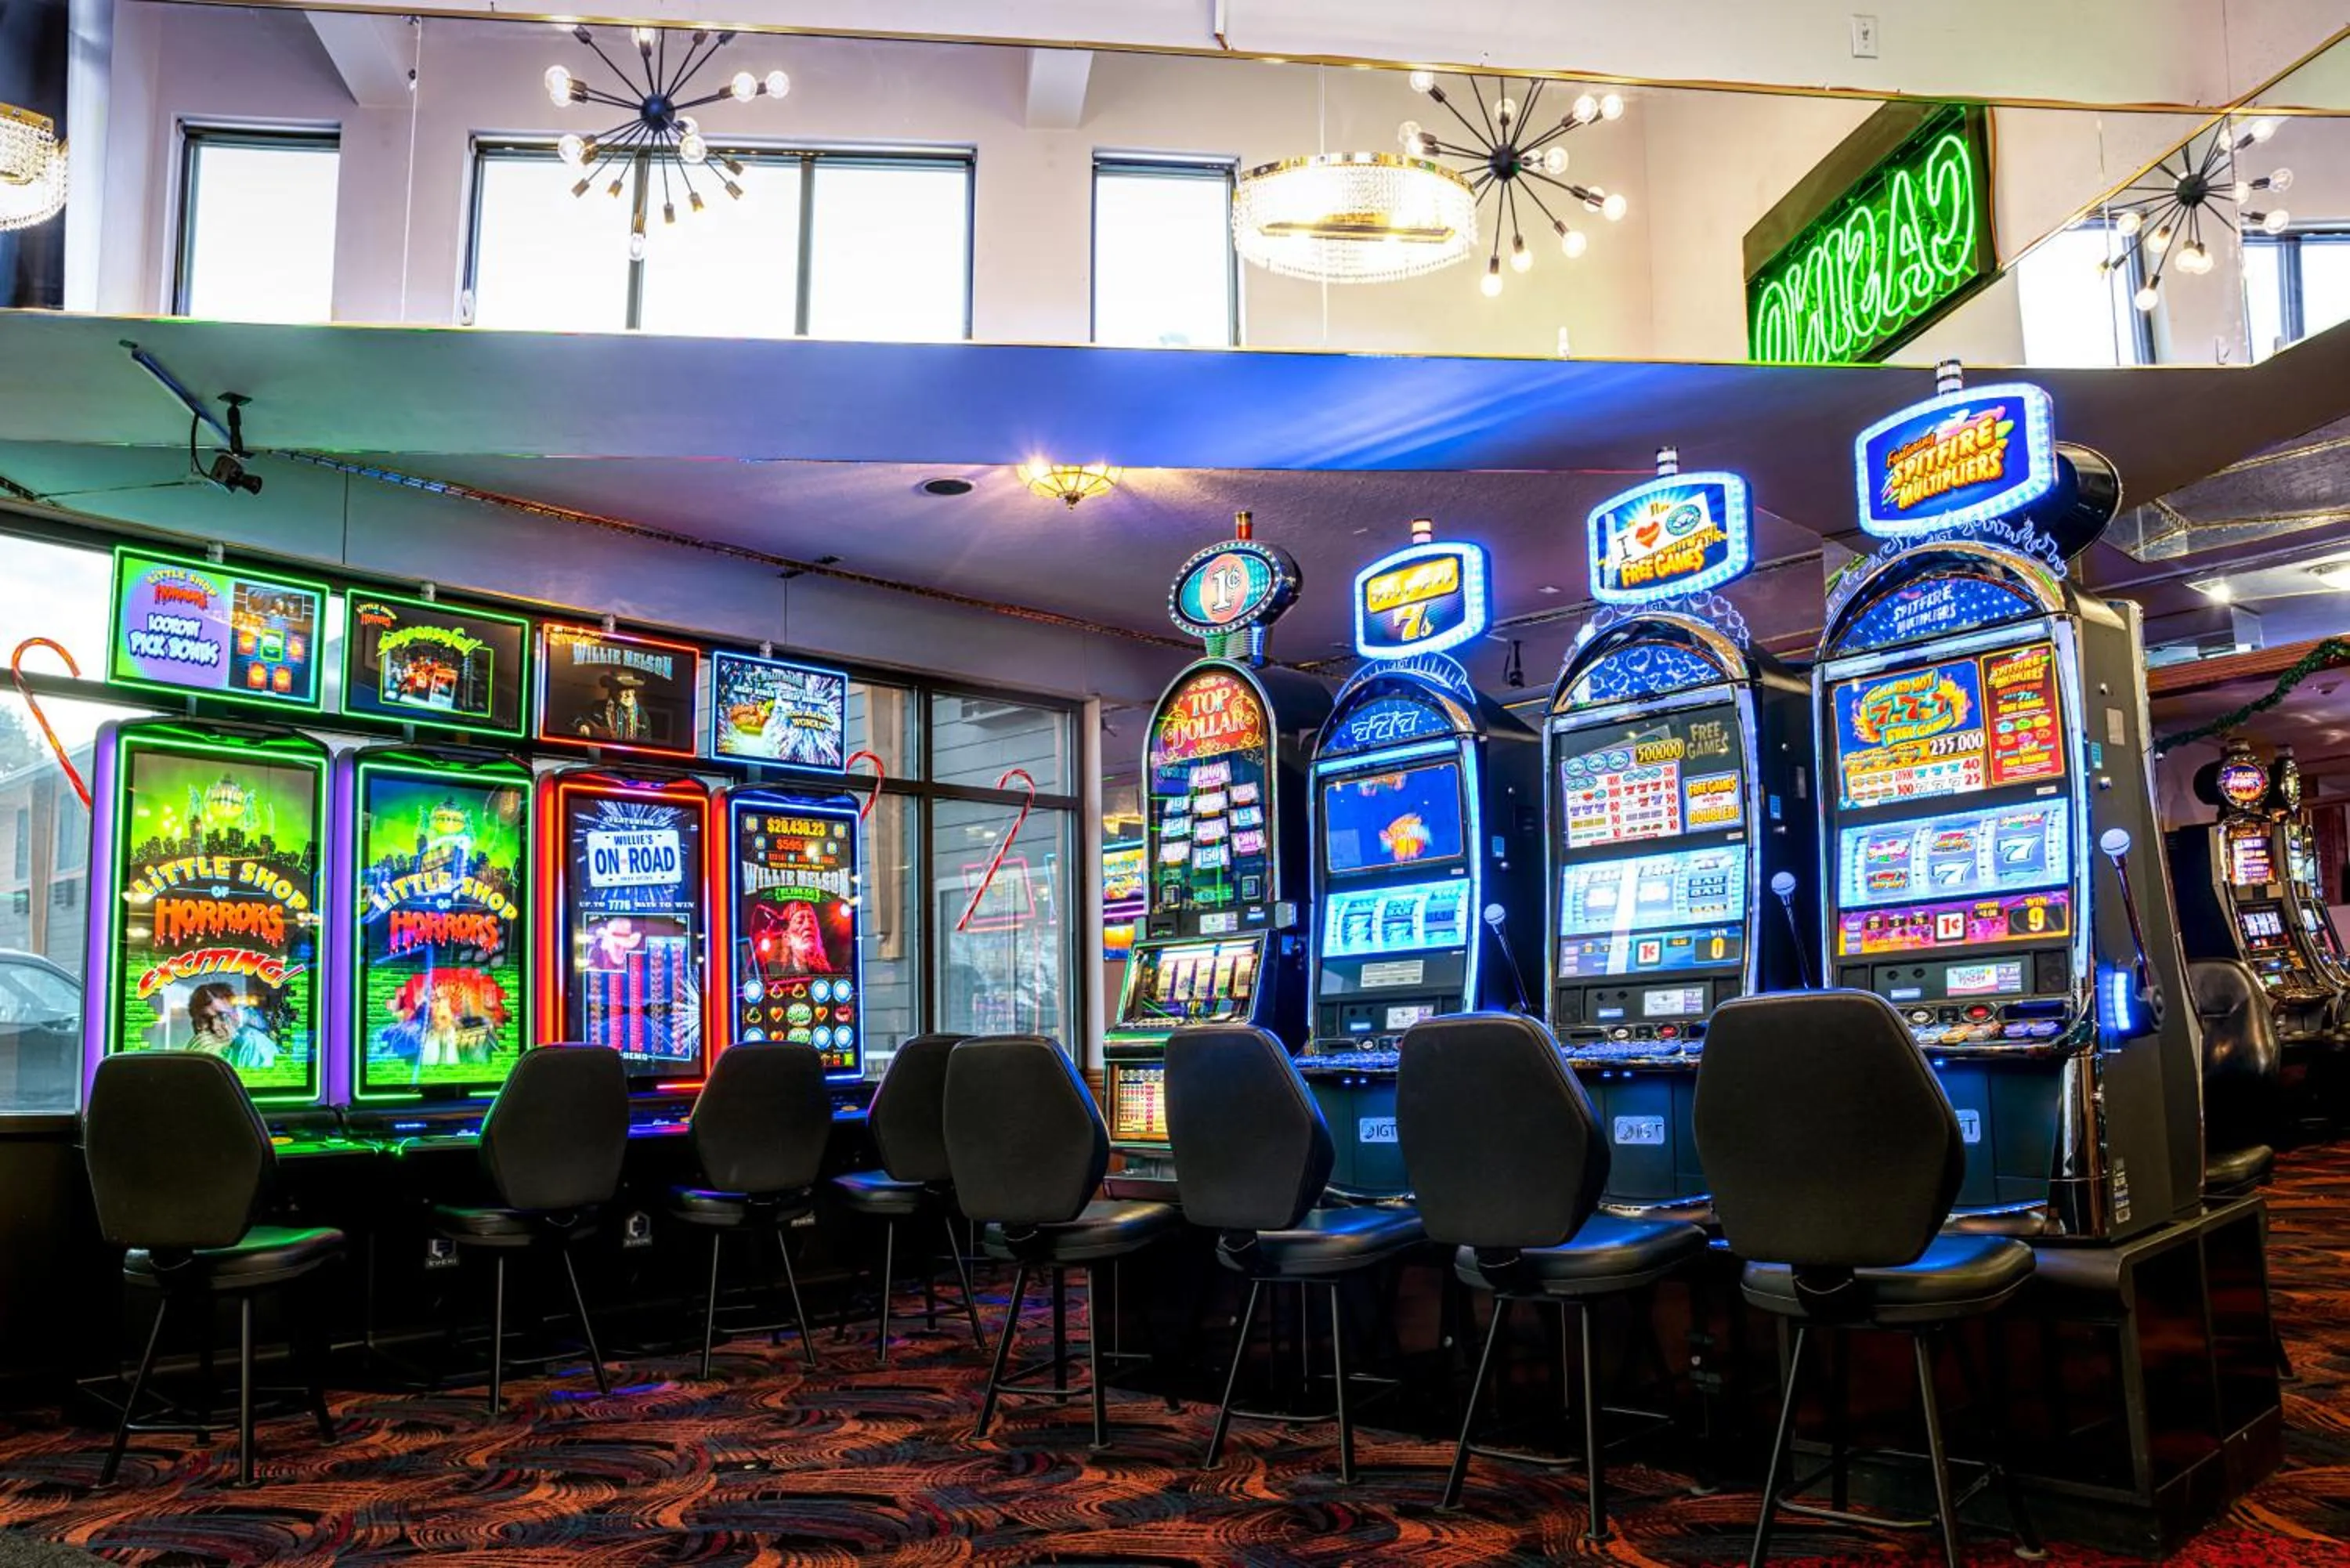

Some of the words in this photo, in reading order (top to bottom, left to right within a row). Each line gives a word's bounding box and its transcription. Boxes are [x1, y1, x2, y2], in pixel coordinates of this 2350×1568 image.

[1892, 416, 1997, 490] SPITFIRE
[1898, 447, 2004, 510] MULTIPLIERS
[1620, 562, 1655, 587] FREE
[1893, 583, 1954, 621] SPITFIRE
[1896, 602, 1957, 636] MULTIPLIERS
[573, 641, 621, 665] WILLIE
[623, 649, 673, 681] NELSON
[1188, 687, 1232, 717] TOP
[1170, 710, 1248, 750] DOLLAR
[1690, 721, 1722, 742] FREE
[1963, 757, 1980, 770] 40
[1690, 805, 1739, 824] DOUBLED!
[613, 833, 654, 845] WILLIE'S
[595, 847, 620, 876] ON
[628, 846, 675, 874] ROAD
[1932, 860, 1974, 885] 7
[132, 855, 232, 898] LITTLE
[238, 861, 309, 910] SHOP
[211, 885, 230, 898] OF
[371, 871, 452, 912] LITTLE
[460, 876, 519, 919] SHOP
[742, 861, 795, 895] WILLIE
[797, 868, 851, 901] NELSON
[2025, 896, 2047, 907] WIN
[154, 898, 285, 948] HORRORS
[389, 910, 499, 955] HORRORS
[1942, 916, 1961, 935] 1¢
[2028, 907, 2044, 931] 9
[1376, 1124, 1397, 1137] IGT
